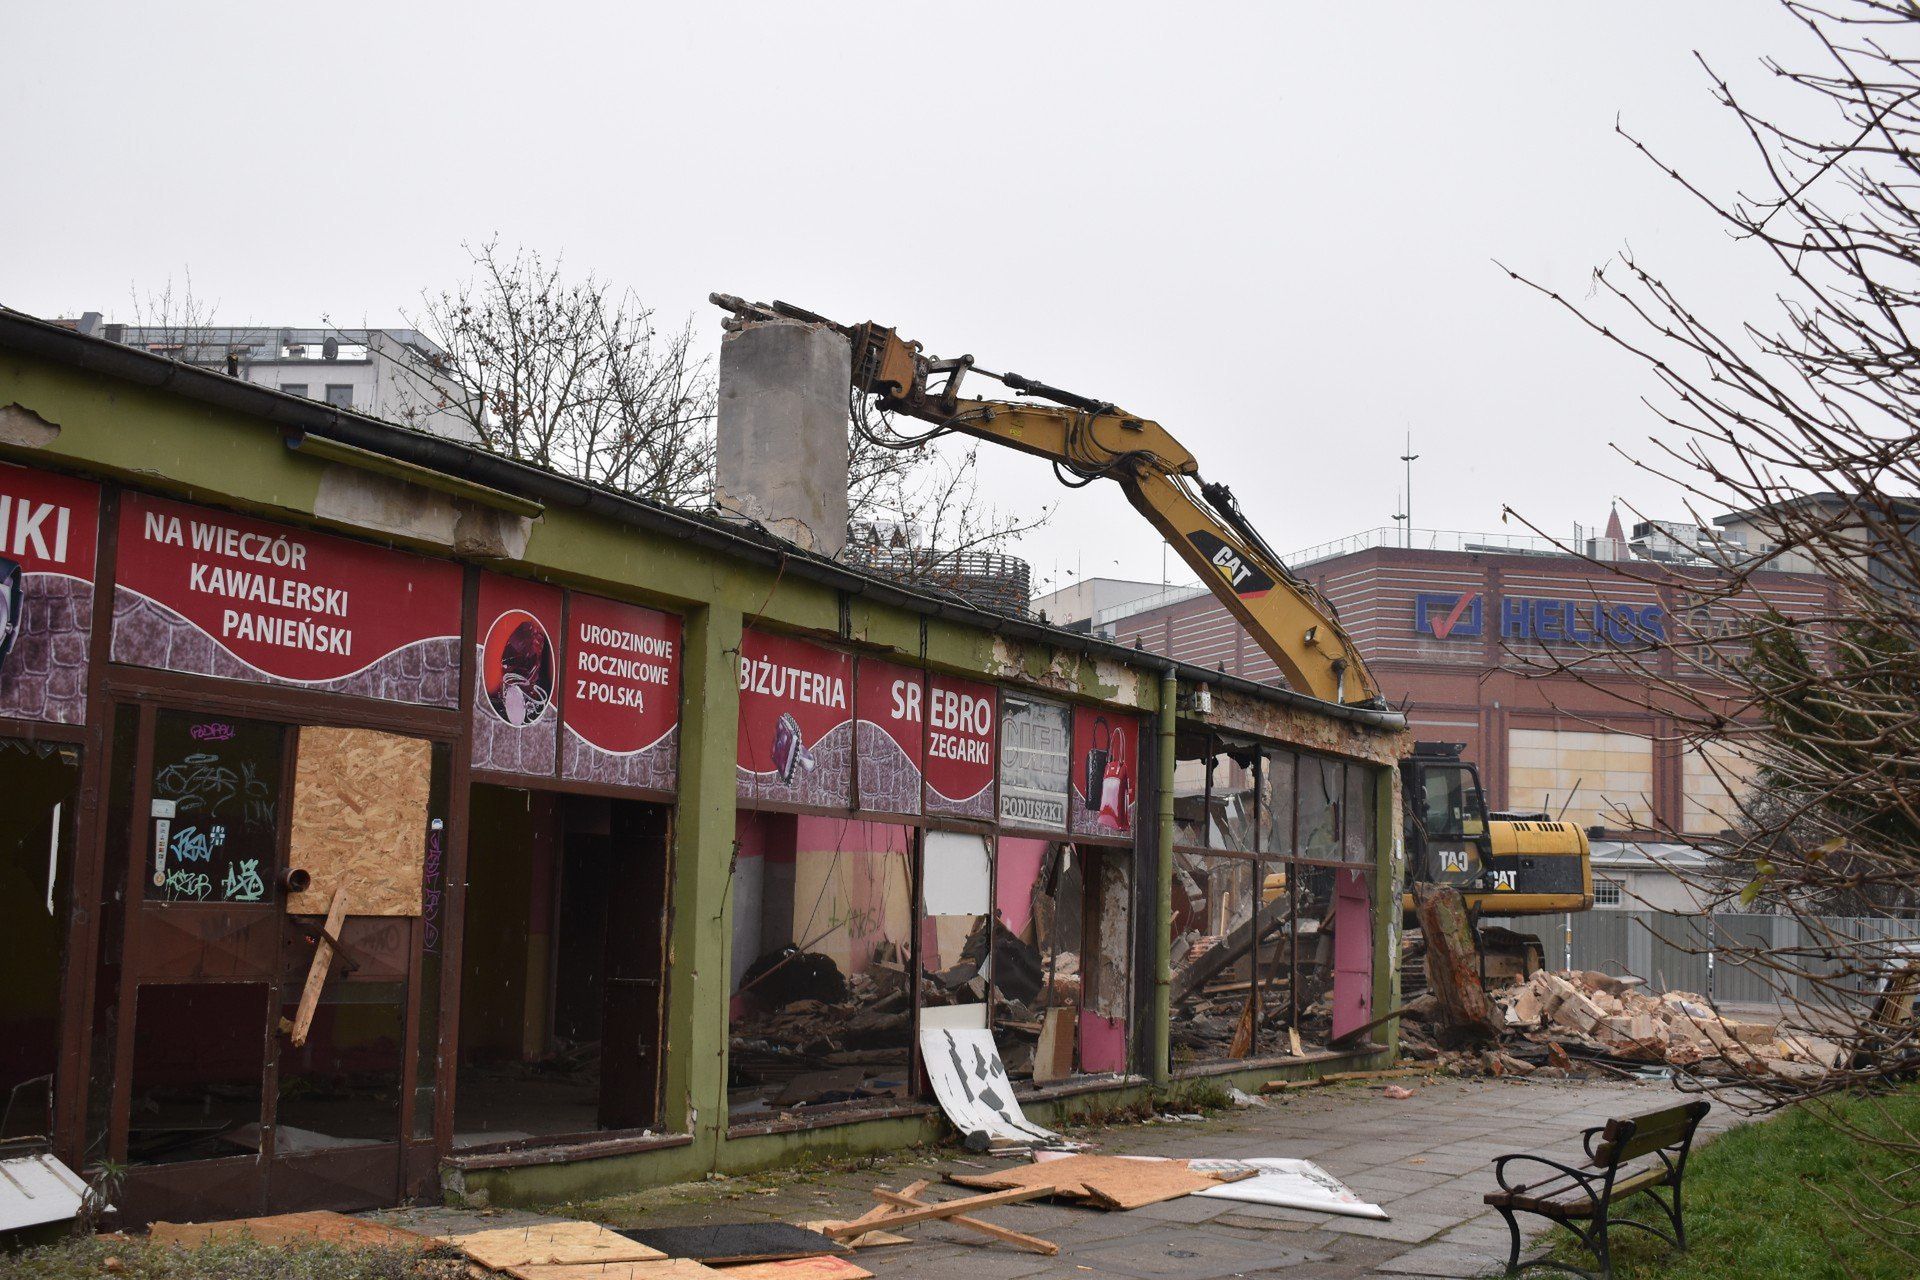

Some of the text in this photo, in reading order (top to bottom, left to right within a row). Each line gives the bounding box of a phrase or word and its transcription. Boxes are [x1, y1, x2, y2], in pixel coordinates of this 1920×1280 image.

[145, 512, 307, 571] NA WIECZÓR
[1212, 546, 1252, 587] CAT
[190, 563, 348, 617] KAWALERSKI
[223, 609, 352, 656] PANIEŃSKI
[1501, 598, 1665, 644] HELIOS
[578, 651, 669, 686] ROCZNICOWE
[740, 655, 846, 709] BIŻUTERIA
[576, 680, 644, 714] Z POLSKĄ
[928, 732, 989, 765] ZEGARKI
[1001, 796, 1062, 821] PODUSZKI
